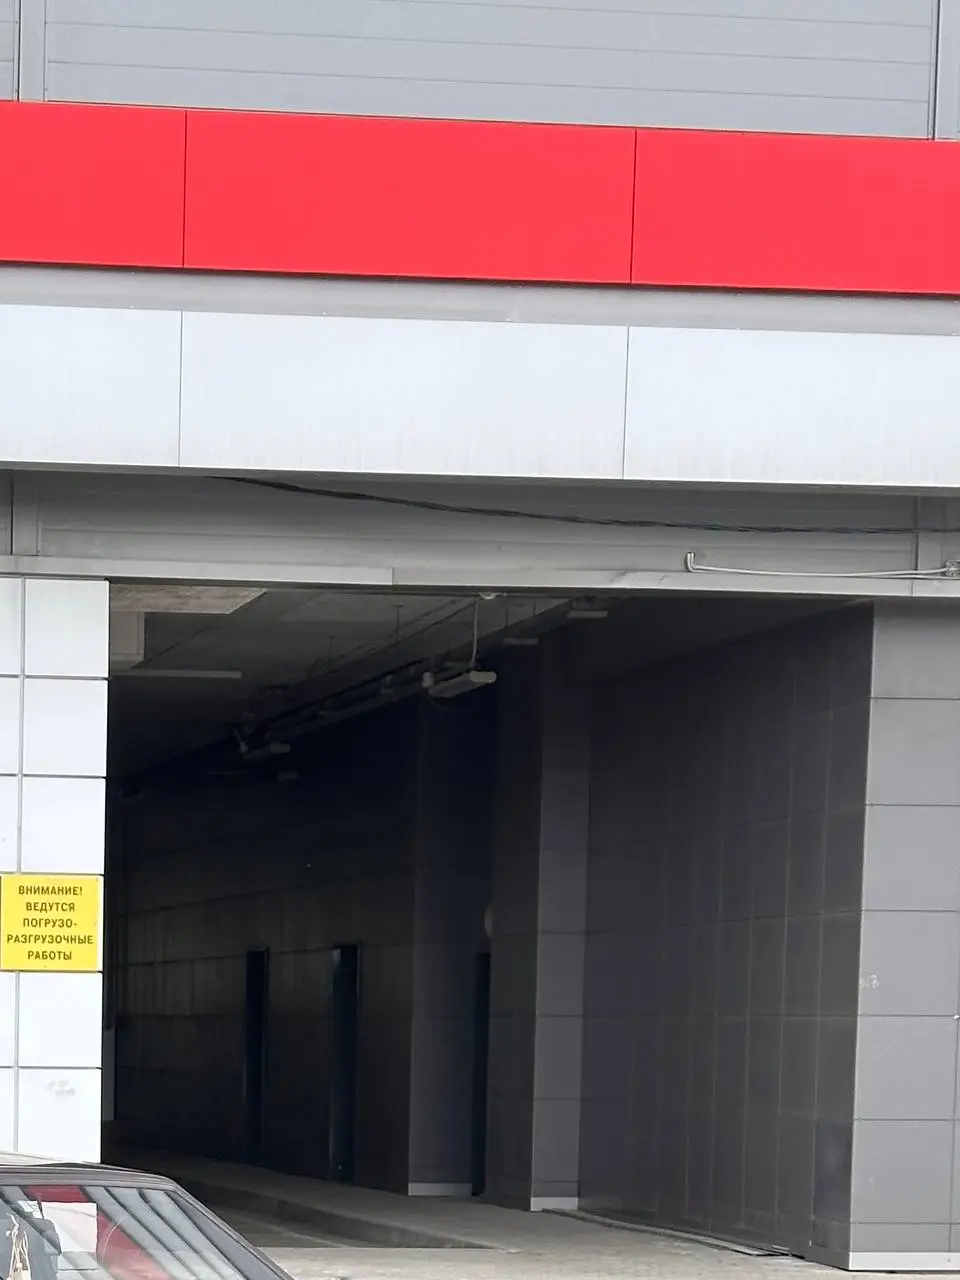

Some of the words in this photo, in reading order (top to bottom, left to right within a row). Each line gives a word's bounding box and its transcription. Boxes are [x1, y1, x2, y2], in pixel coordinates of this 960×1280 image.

[18, 885, 83, 896] ВНИМАНИЕ!
[26, 902, 75, 913] ВЕДУТСЯ
[23, 918, 77, 928] ПОГРУЗО-
[6, 934, 94, 945] РАЗГРУЗОЧНЫЕ
[27, 951, 72, 961] РАБОТЫ
